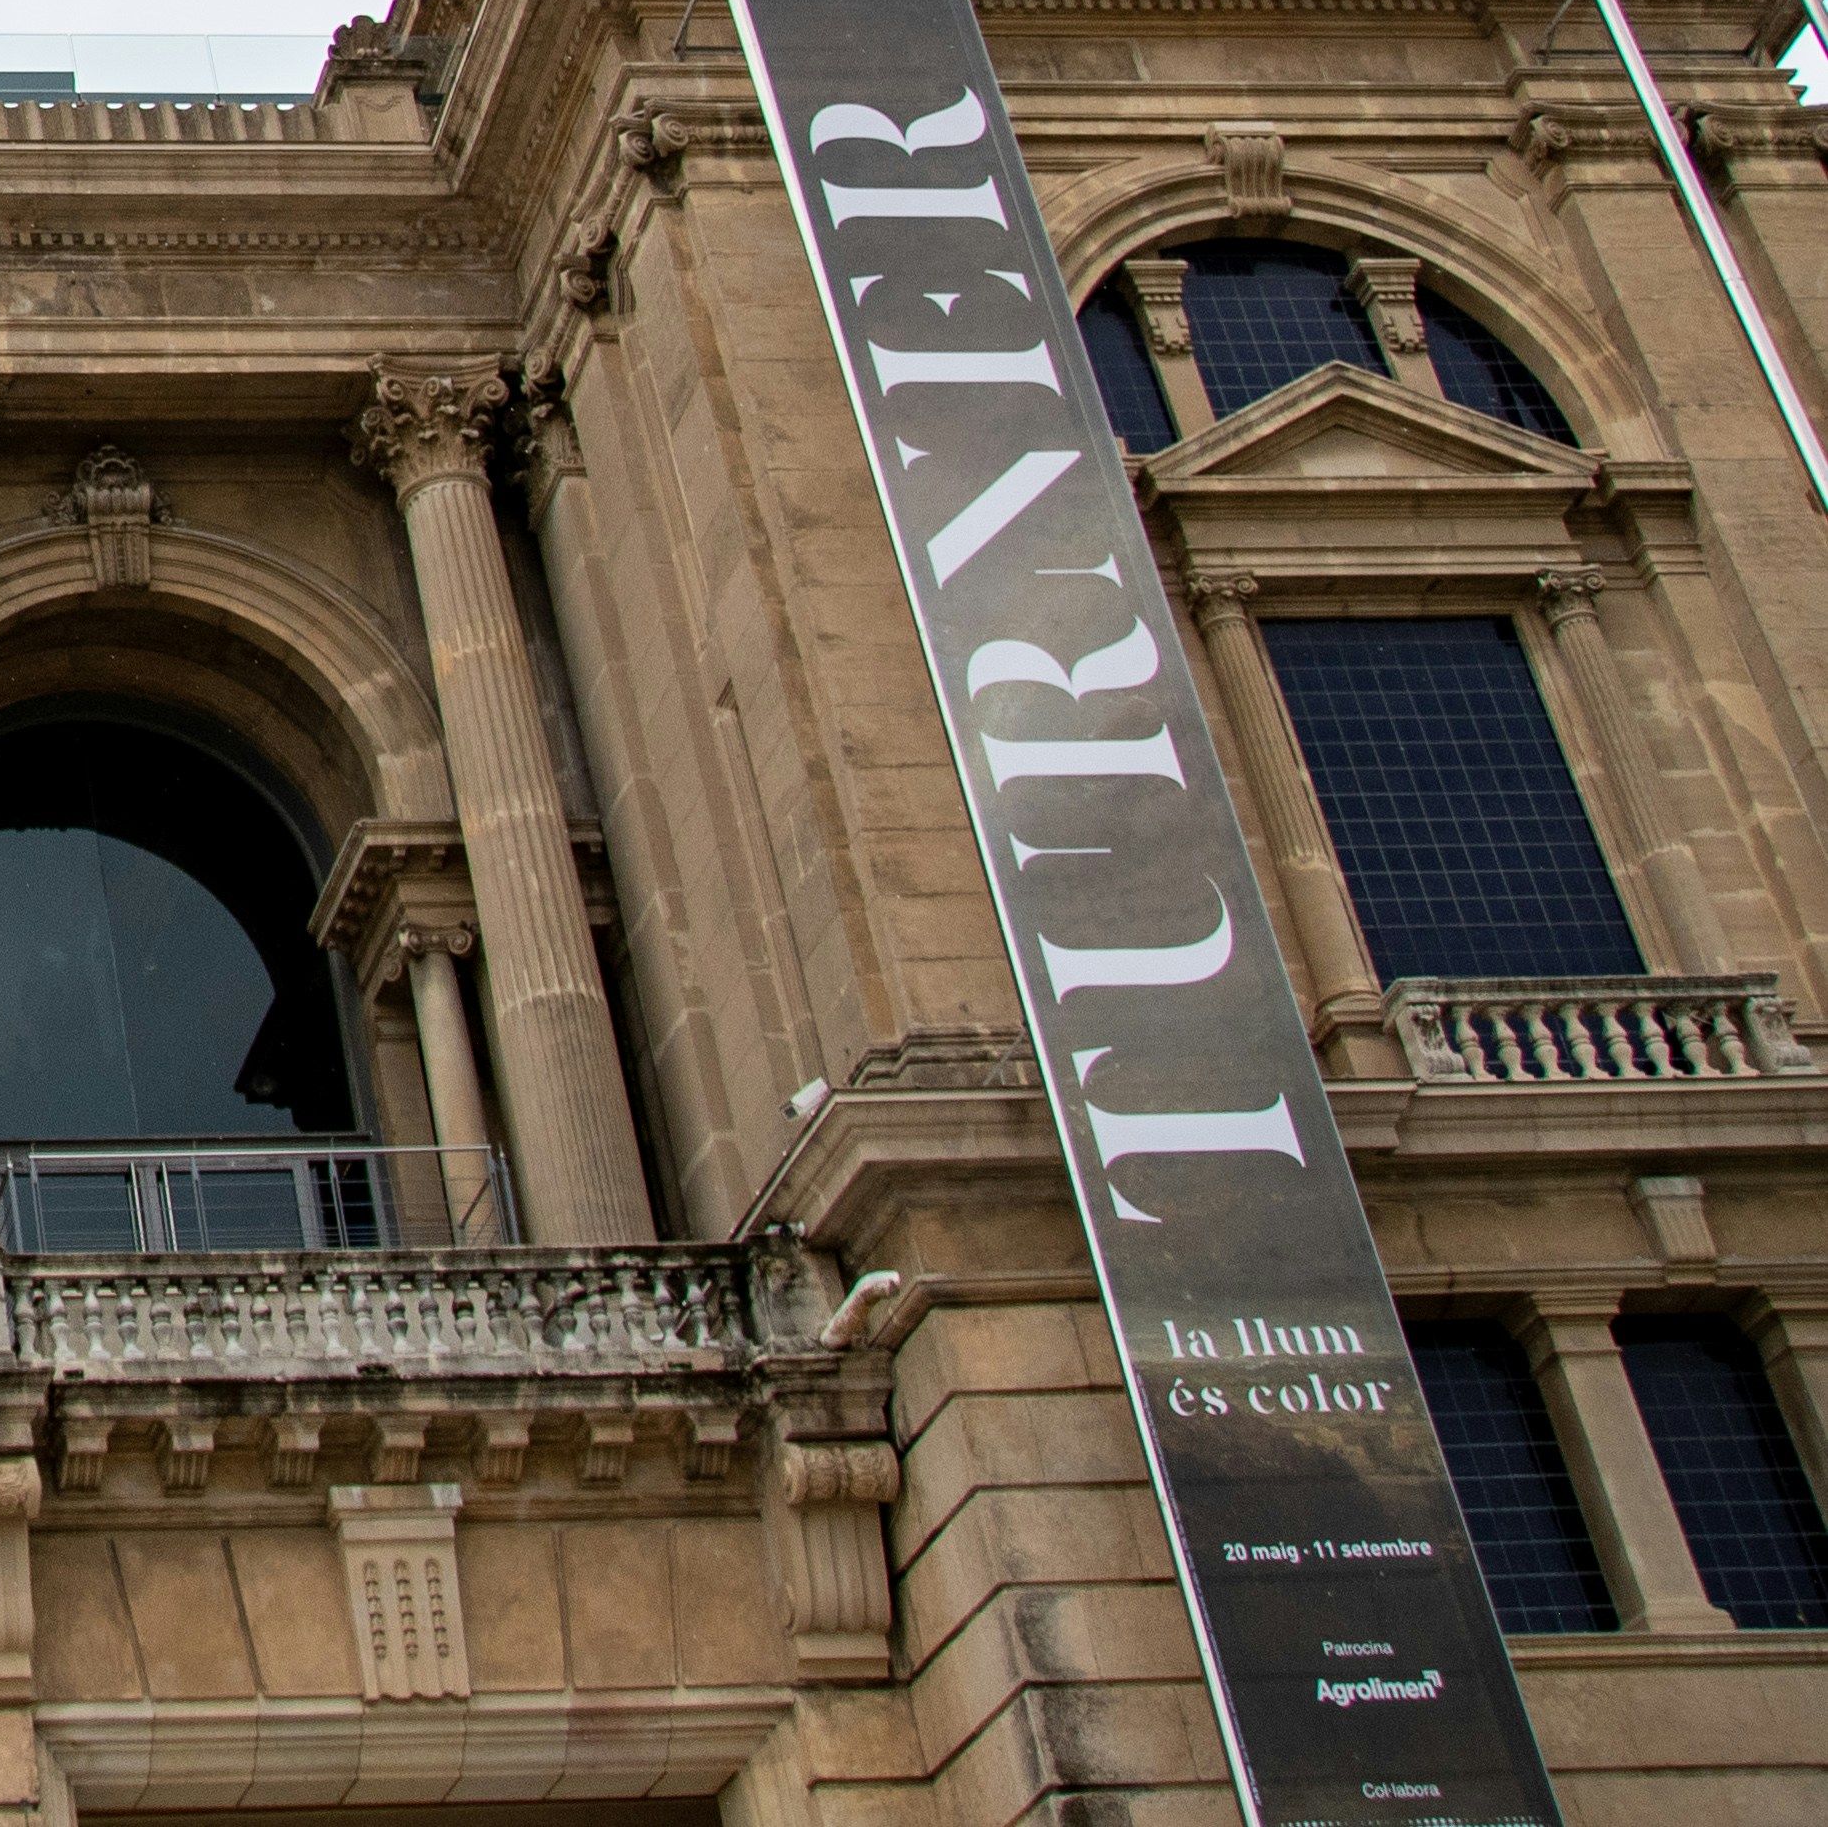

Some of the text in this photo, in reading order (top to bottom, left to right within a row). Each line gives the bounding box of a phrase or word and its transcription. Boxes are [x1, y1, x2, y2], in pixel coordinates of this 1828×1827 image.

[809, 84, 1306, 1224] TURNER
[1162, 1318, 1365, 1359] la llum
[1168, 1373, 1392, 1417] és color
[1223, 1542, 1248, 1562] 20
[1251, 1540, 1301, 1565] maig
[1313, 1540, 1337, 1560] 11
[1340, 1538, 1433, 1559] setembre
[1321, 1639, 1395, 1658] Patrocina
[1316, 1675, 1439, 1708] Agrolimen
